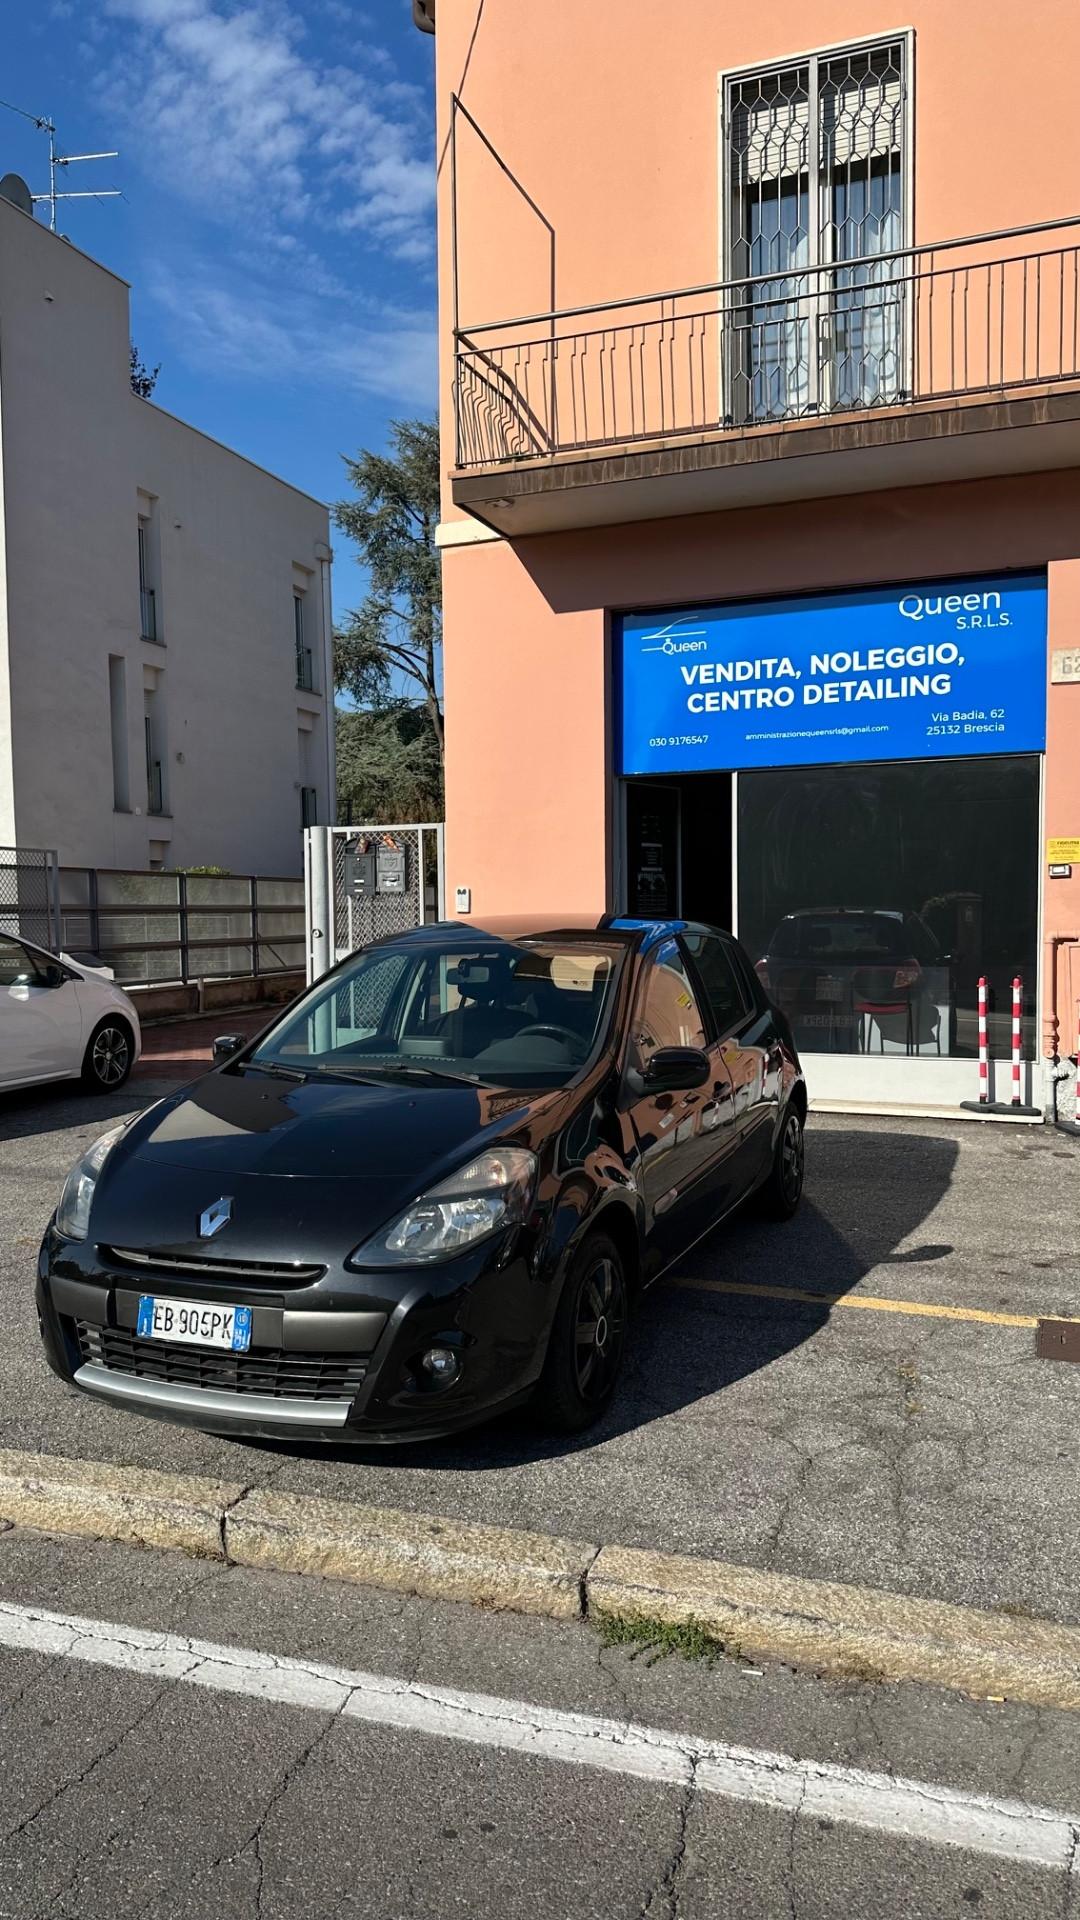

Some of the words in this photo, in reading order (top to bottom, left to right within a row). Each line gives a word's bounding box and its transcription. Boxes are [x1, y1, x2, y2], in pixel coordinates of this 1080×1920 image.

[899, 591, 1001, 620] Queen
[956, 612, 1013, 630] S.R.L.S.
[662, 639, 708, 656] Queen
[680, 657, 801, 685] VENDITA,
[810, 642, 965, 675] NOLEGGIO,
[687, 686, 795, 713] CENTRO
[803, 673, 951, 704] DETAILING
[931, 712, 949, 722] Via
[952, 710, 987, 721] Badia,
[990, 708, 1005, 719] 62
[745, 725, 889, 740] amministrazionequeensrls@gmail.com
[926, 724, 961, 736] 25132
[963, 721, 1005, 734] Brescia
[649, 737, 667, 747] 030
[669, 734, 709, 746] 9176547
